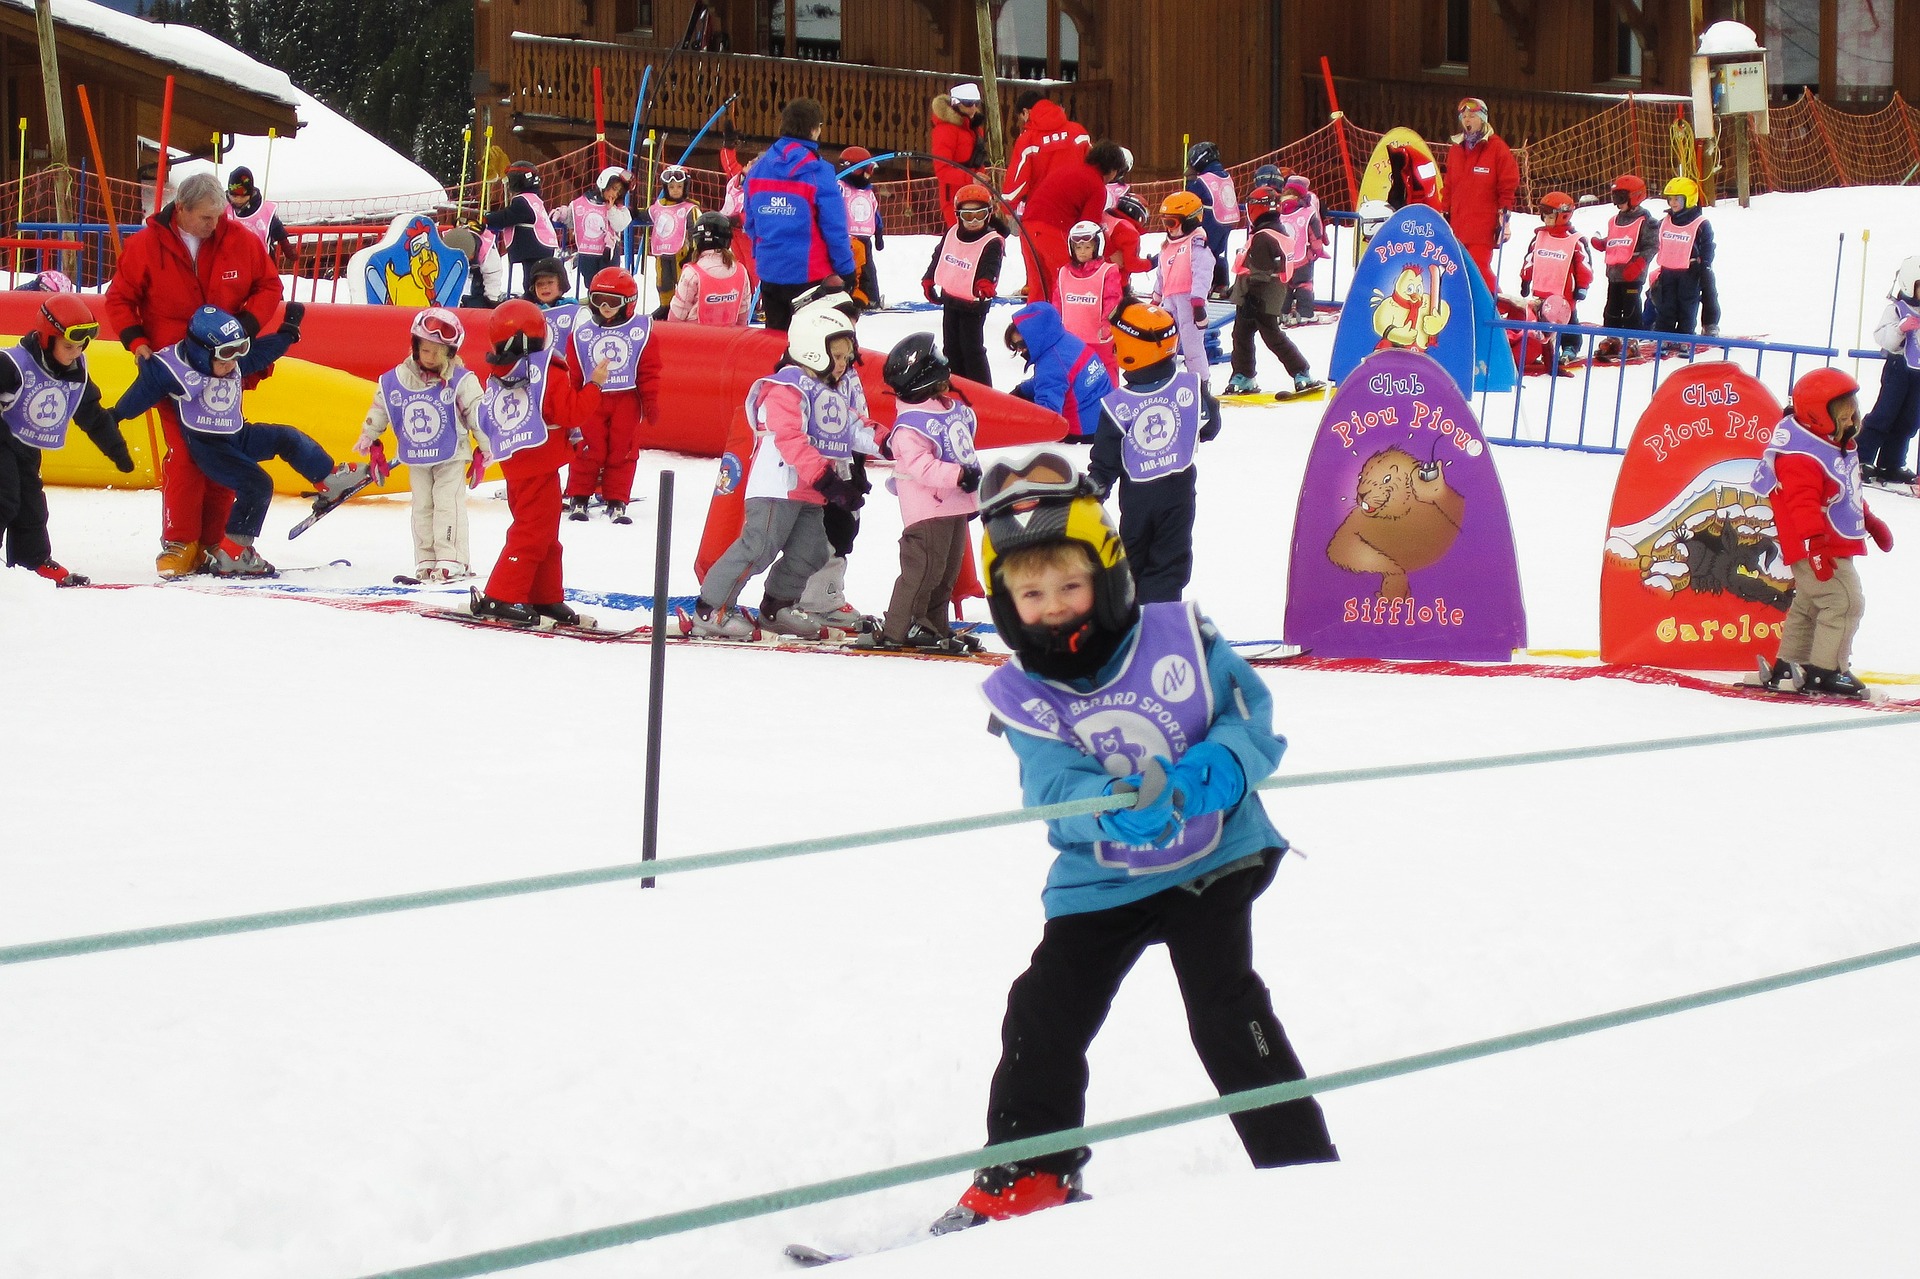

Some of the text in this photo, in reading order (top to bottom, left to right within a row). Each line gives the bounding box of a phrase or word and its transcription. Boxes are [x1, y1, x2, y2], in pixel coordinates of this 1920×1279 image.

[1042, 131, 1068, 145] ESF
[770, 196, 787, 207] SKI
[1401, 220, 1435, 237] Club
[945, 254, 972, 270] ESPRIT
[1375, 240, 1458, 275] Piou Piou
[706, 292, 739, 303] ESPRIT
[1066, 293, 1097, 304] ESPRIT
[1370, 372, 1425, 396] Club
[1138, 396, 1169, 410] BERARD
[1682, 382, 1740, 407] Club
[1332, 400, 1474, 451] Piou Piou
[1644, 410, 1774, 462] Piou Pio
[1343, 597, 1465, 625] Sifflote
[1068, 691, 1138, 717] BERARD
[1138, 696, 1189, 754] SPORTS
